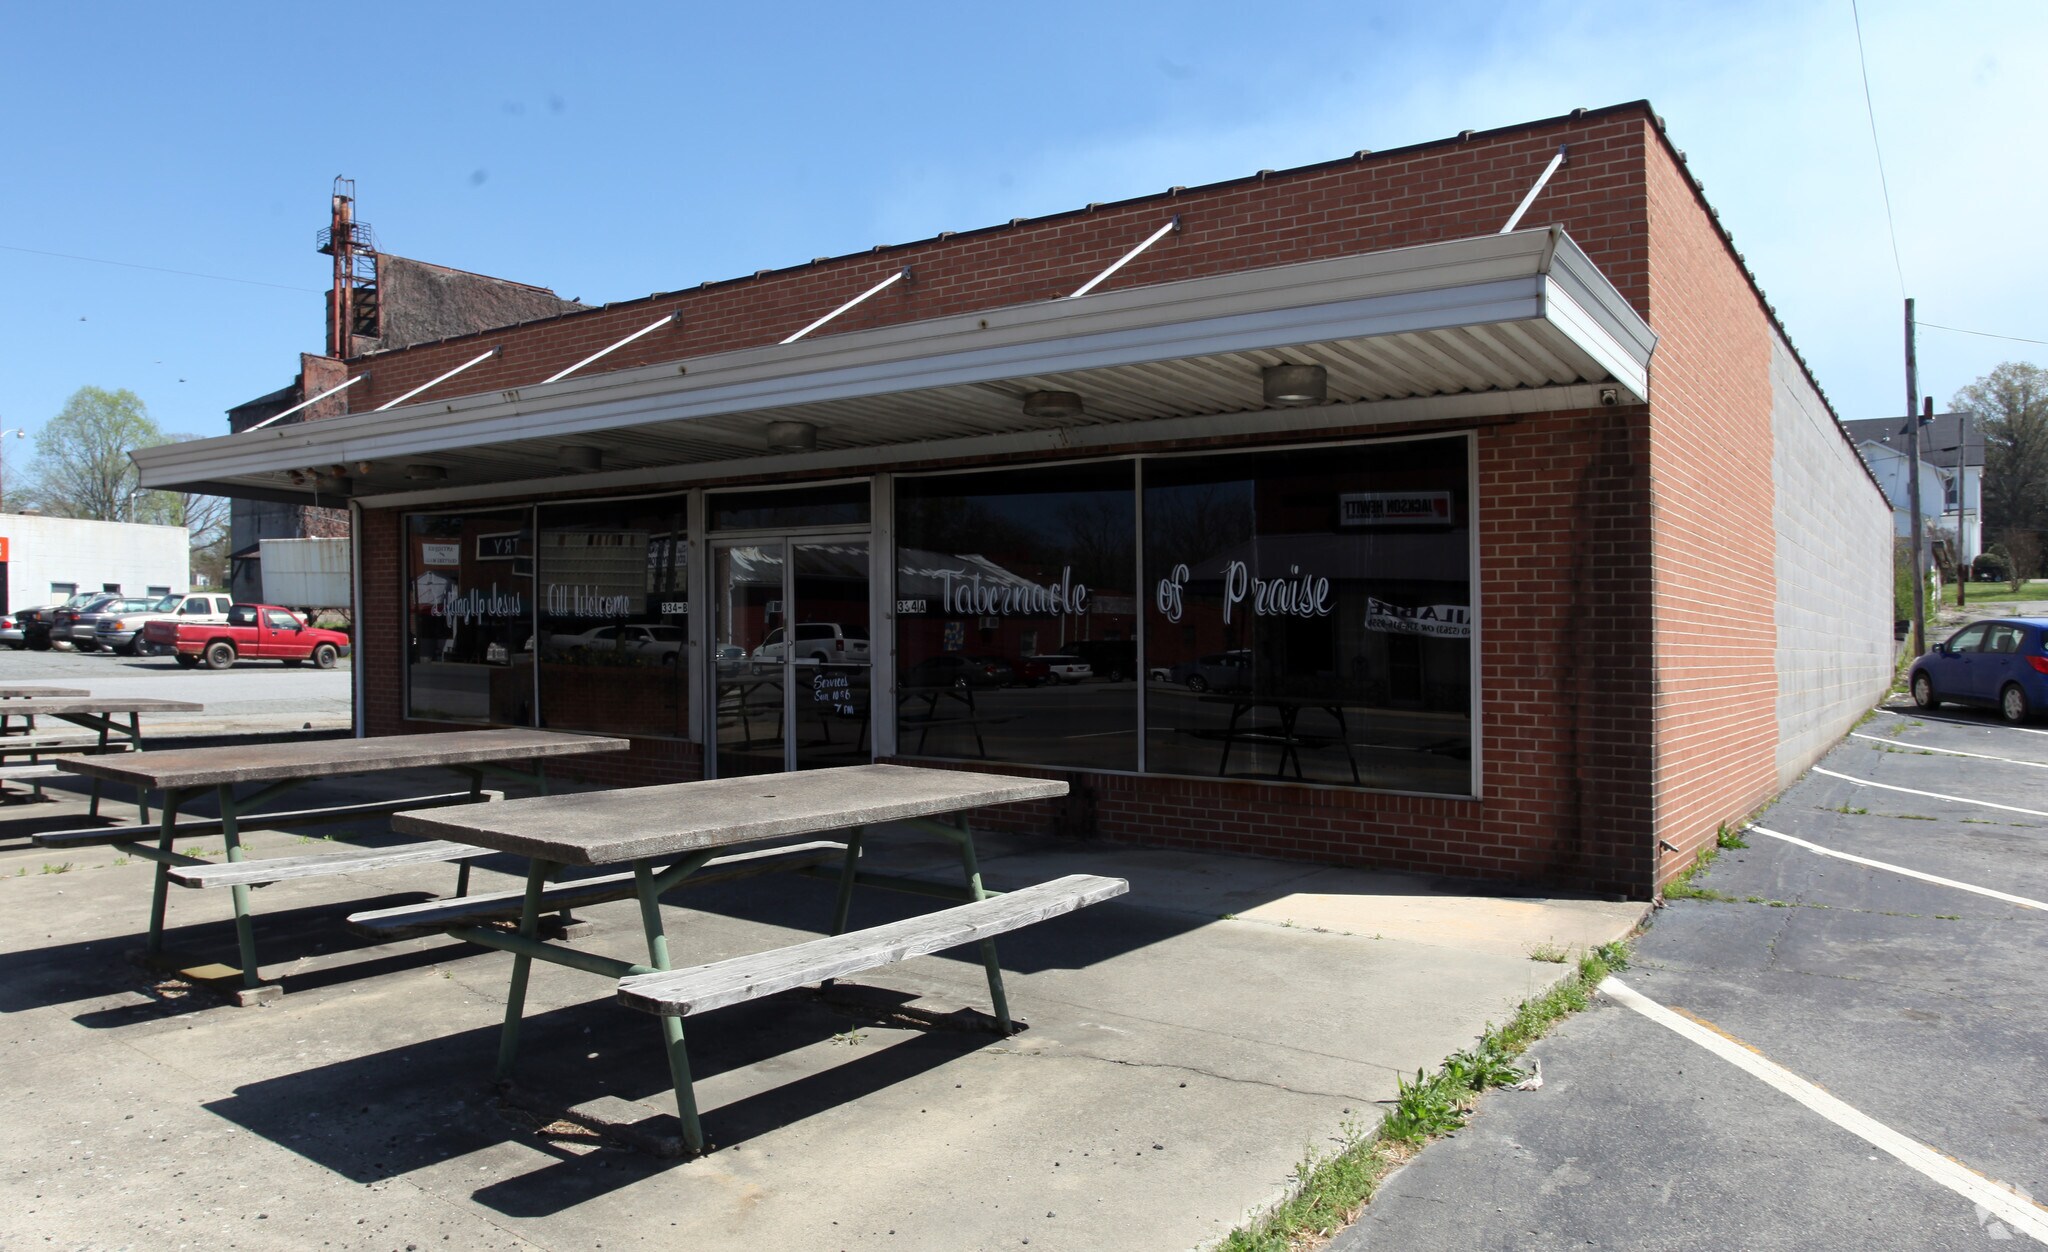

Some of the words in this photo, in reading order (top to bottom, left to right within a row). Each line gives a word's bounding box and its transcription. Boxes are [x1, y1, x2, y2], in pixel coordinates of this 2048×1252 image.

[470, 587, 485, 625] Up
[487, 582, 521, 617] Jesus
[547, 583, 568, 617] All
[574, 584, 630, 618] Welcome
[662, 602, 688, 614] 334-B
[932, 565, 1089, 616] Tabernacle
[1156, 563, 1190, 624] of
[1218, 560, 1338, 625] Praise
[813, 674, 848, 690] Services
[814, 689, 830, 702] Sun
